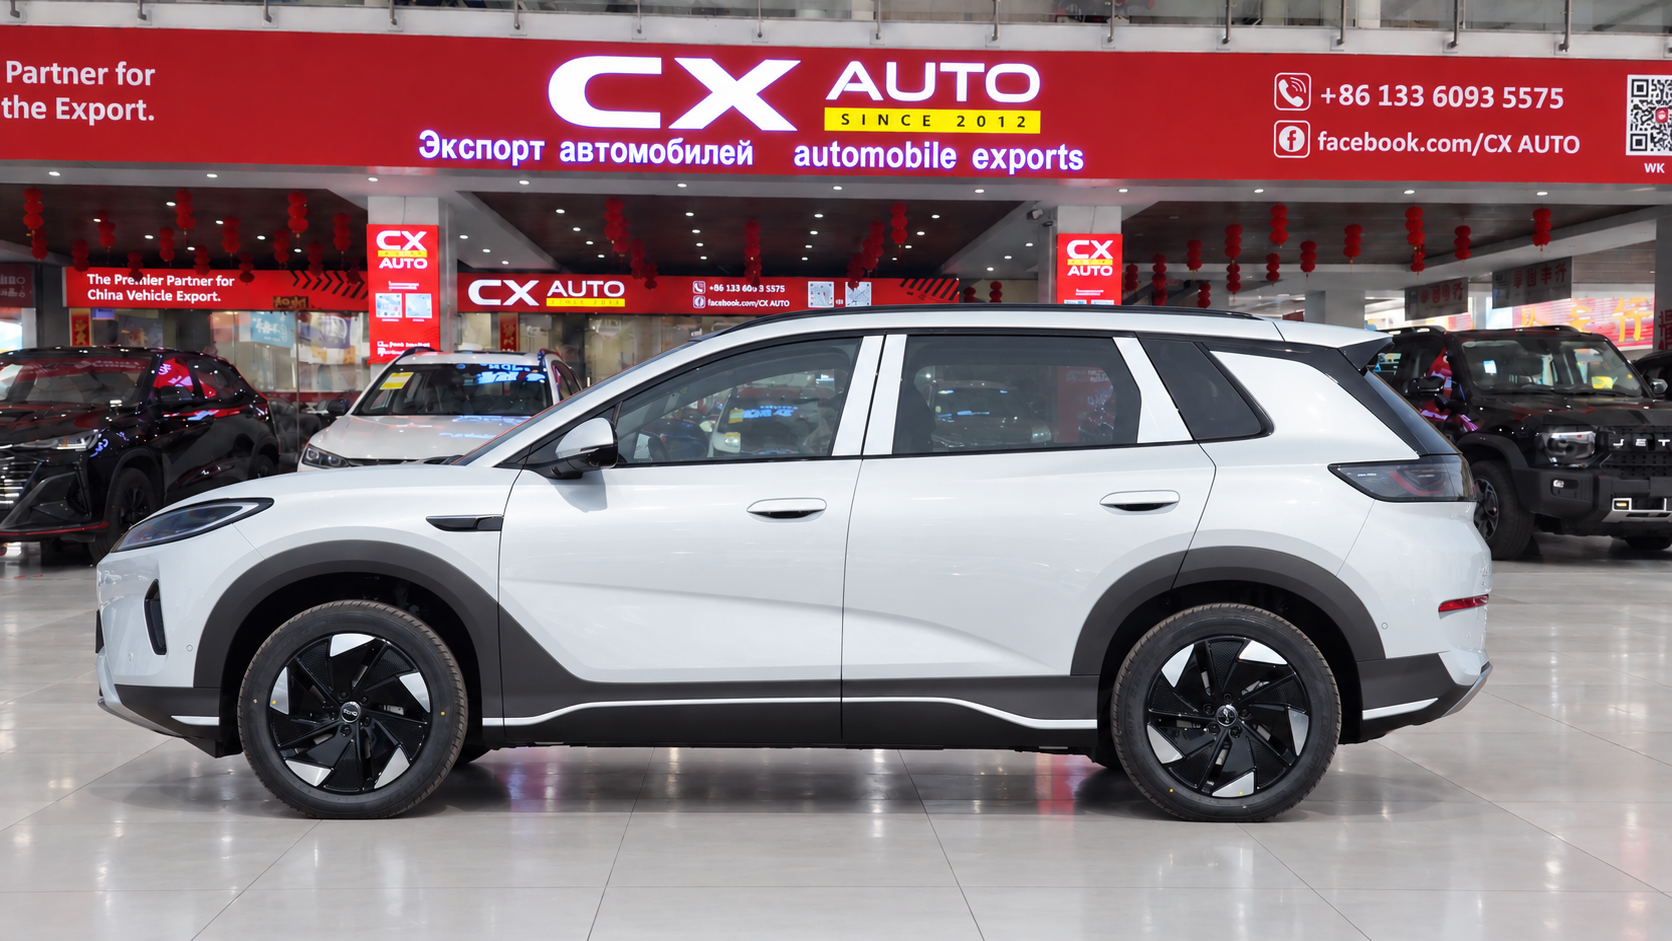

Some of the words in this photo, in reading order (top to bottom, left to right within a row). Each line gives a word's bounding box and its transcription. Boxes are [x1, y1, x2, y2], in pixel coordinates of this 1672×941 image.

[6, 61, 109, 85] Partner
[115, 61, 156, 86] for
[825, 61, 1041, 103] AUTO
[548, 56, 801, 131] CX
[1320, 84, 1370, 106] +86
[1378, 84, 1425, 107] 133
[1432, 85, 1495, 108] 6093
[1502, 86, 1564, 109] 5575
[1, 95, 47, 119] the
[56, 97, 155, 126] Export.
[841, 113, 931, 127] SINCE
[956, 115, 1026, 128] 2012
[418, 130, 546, 167] Экспорт
[559, 137, 754, 166] автомобилей
[1317, 131, 1512, 156] facebook.com/CX
[1517, 134, 1581, 155] AUTO
[793, 141, 957, 170] automobile
[971, 143, 1084, 175] exports
[1643, 162, 1665, 174] WK
[376, 230, 427, 250] CX
[1066, 239, 1114, 259] CX
[378, 257, 428, 269] AUTO
[1066, 265, 1114, 277] AUTO
[86, 273, 111, 285] The
[166, 275, 214, 287] Partner
[215, 275, 236, 287] for
[546, 279, 625, 297] AUTO
[87, 289, 124, 301] China
[126, 289, 173, 301] Vehicle
[176, 290, 222, 304] Export.
[468, 279, 540, 306] CX
[769, 299, 790, 307] AUTO
